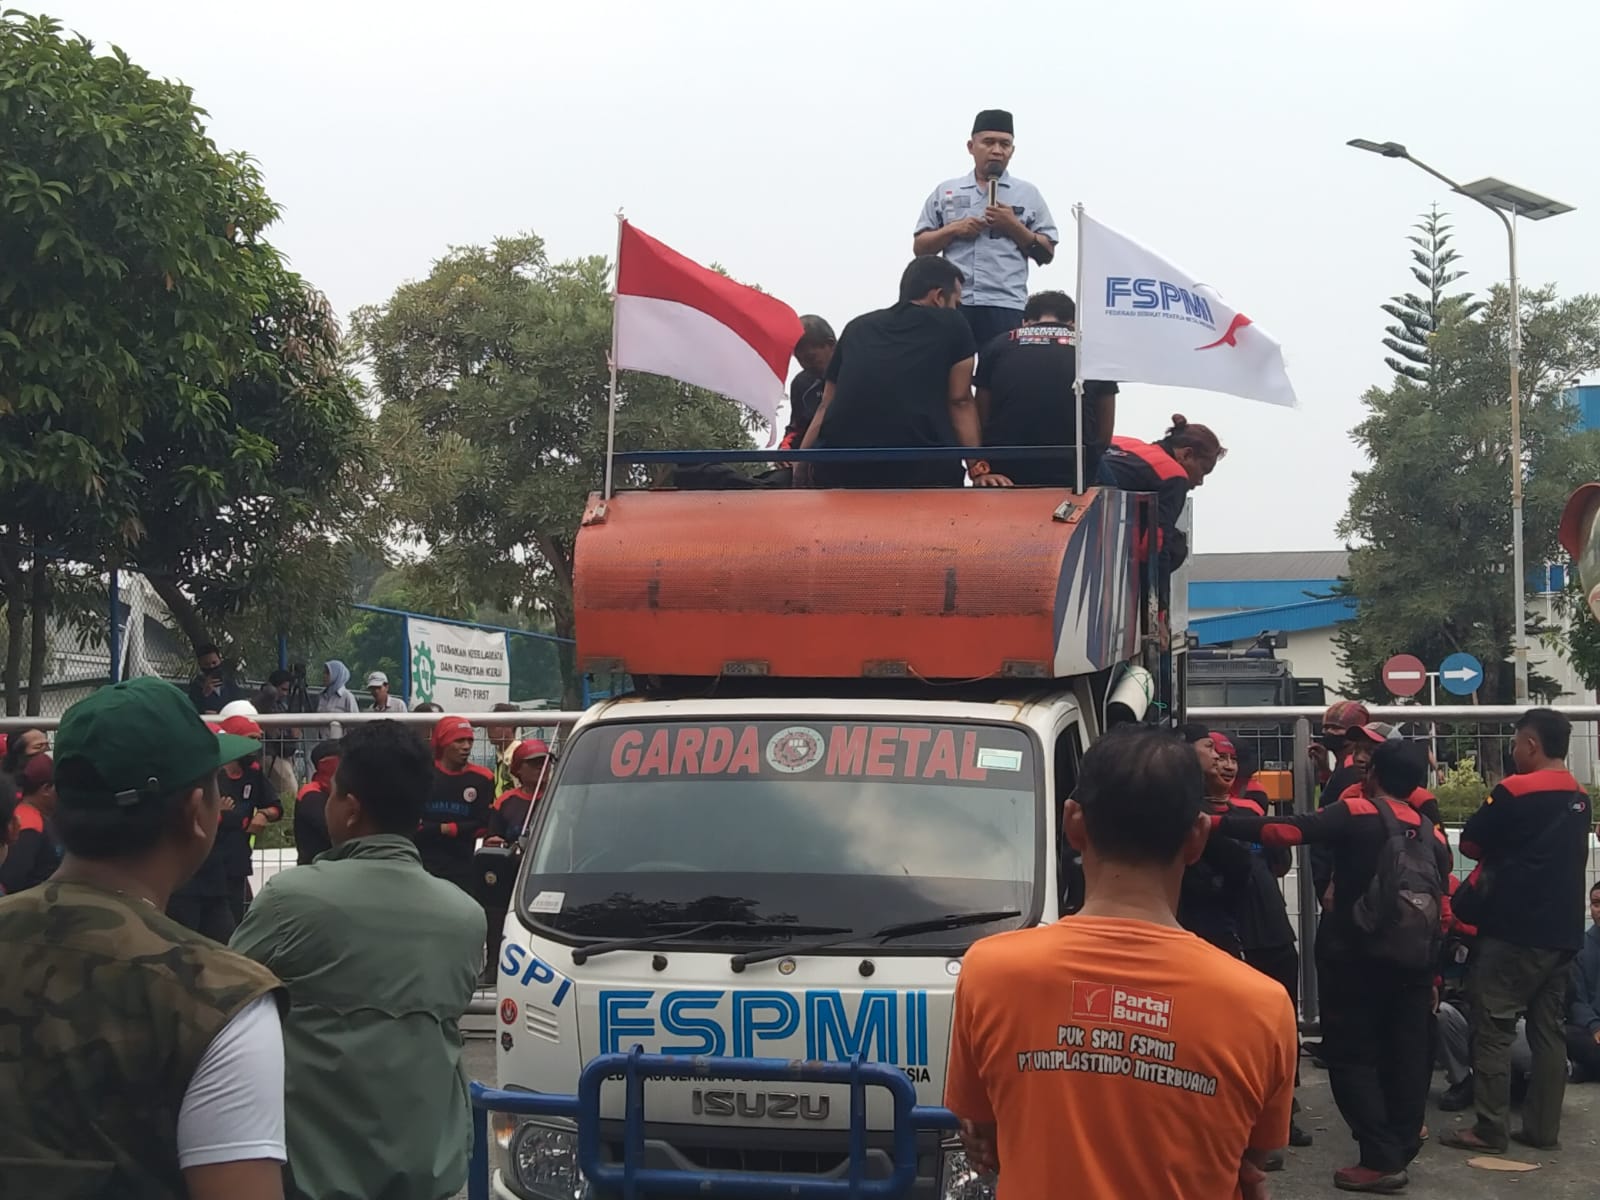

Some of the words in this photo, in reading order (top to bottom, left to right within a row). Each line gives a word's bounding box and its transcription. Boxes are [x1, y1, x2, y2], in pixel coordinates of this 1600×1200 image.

[1105, 276, 1215, 325] FSPMI
[440, 662, 453, 672] DAN
[473, 689, 489, 700] FIRST
[610, 726, 760, 778] GARDA
[825, 726, 988, 782] METAL
[501, 943, 572, 1008] SPI
[1112, 1005, 1168, 1028] Buruh
[1114, 990, 1169, 1014] Partai
[599, 989, 928, 1066] FSPMI
[1057, 1025, 1086, 1046] PUK
[1091, 1028, 1125, 1050] SPAI
[1017, 1052, 1032, 1072] PT
[1133, 1060, 1218, 1096] INTERBUANA
[692, 1088, 830, 1121] ISUZU
